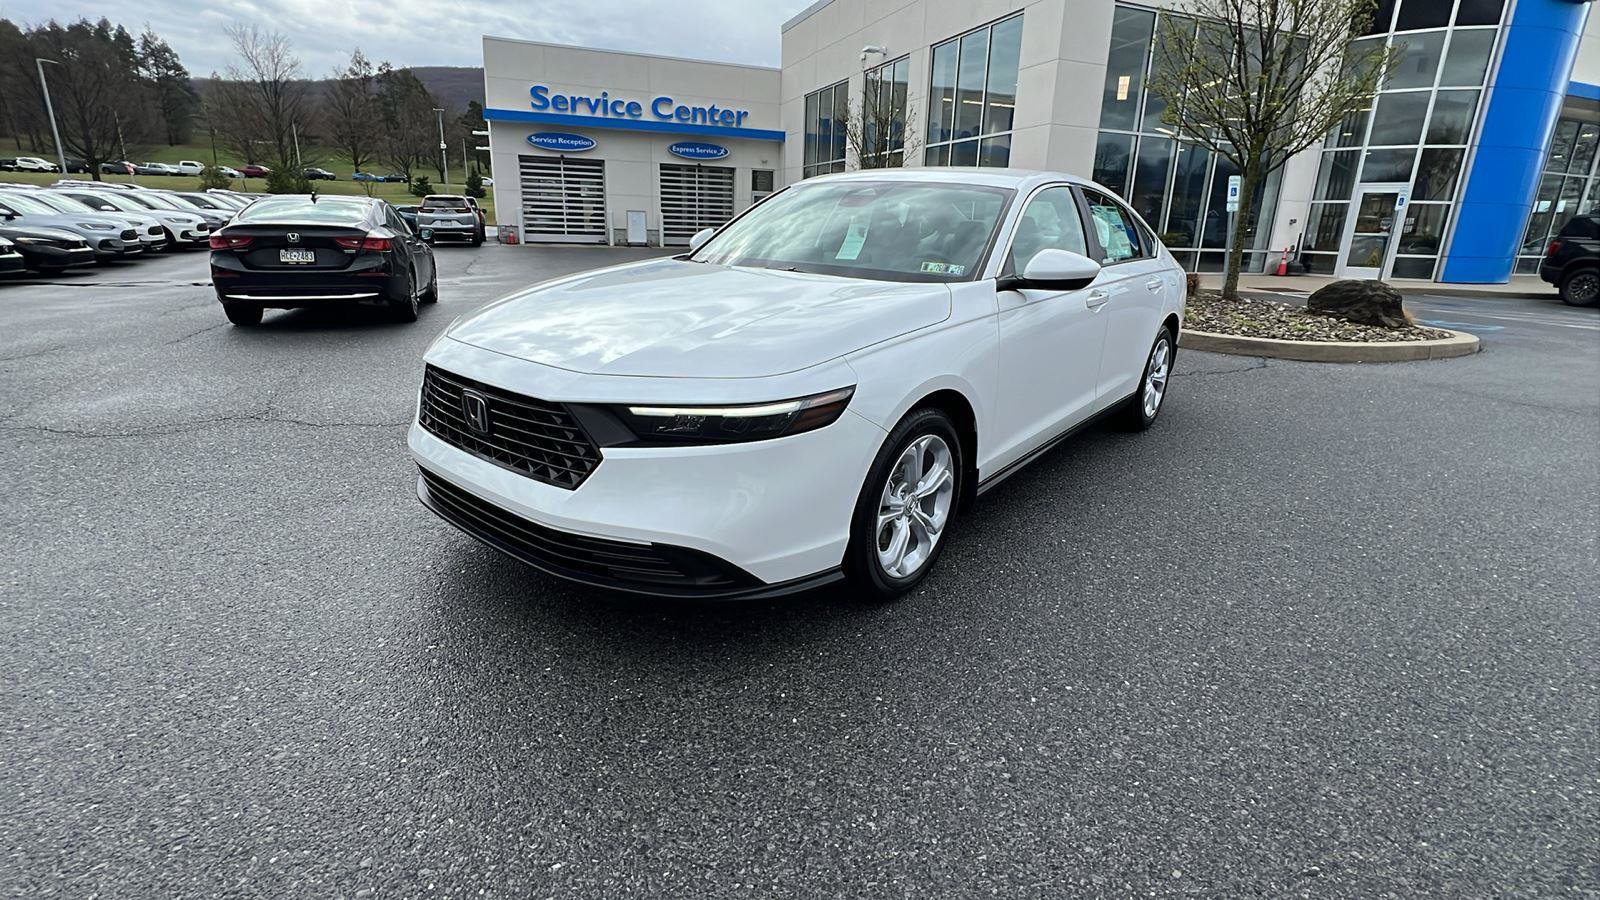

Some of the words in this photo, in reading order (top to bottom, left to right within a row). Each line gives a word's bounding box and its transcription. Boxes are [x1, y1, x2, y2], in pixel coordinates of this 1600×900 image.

[530, 86, 642, 118] Service
[651, 97, 748, 127] Center
[531, 135, 557, 144] Service
[558, 137, 592, 146] Reception
[672, 145, 695, 154] Express
[696, 147, 718, 155] Service
